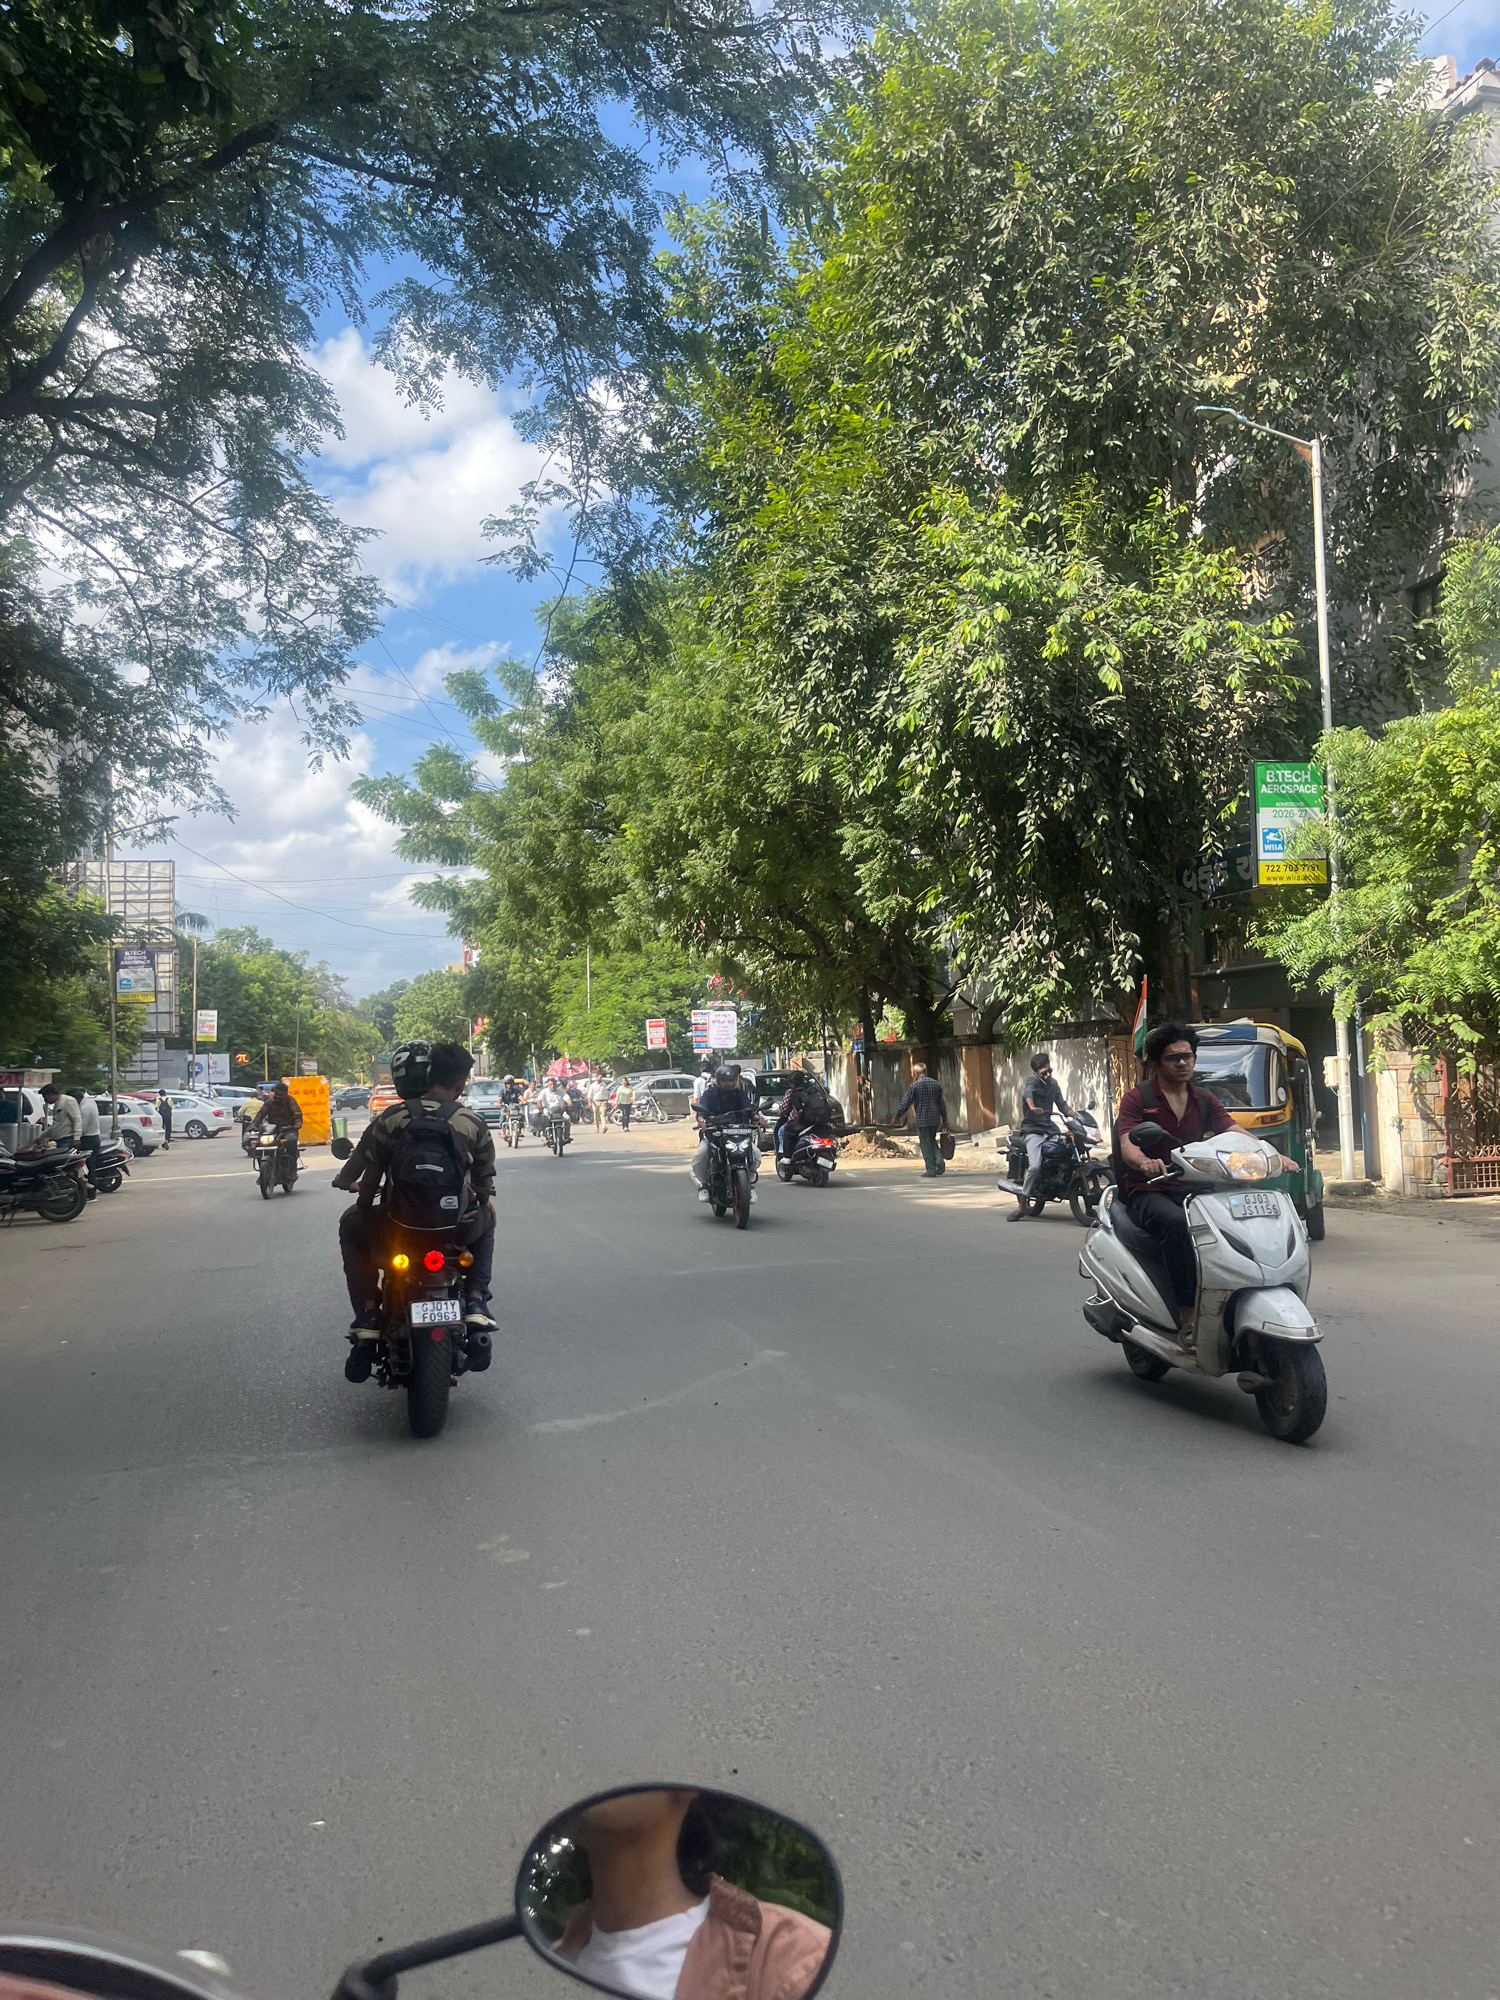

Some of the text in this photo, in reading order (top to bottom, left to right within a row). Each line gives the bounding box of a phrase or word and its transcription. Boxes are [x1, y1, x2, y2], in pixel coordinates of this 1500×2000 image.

[1266, 770, 1311, 783] B.TECH
[1260, 784, 1318, 794] AEROSPACE
[1272, 809, 1308, 819] 2026-27
[1264, 843, 1284, 851] WIIA
[1265, 864, 1281, 872] 722
[1244, 1193, 1269, 1205] GJ03
[1242, 1203, 1279, 1216] JS1156
[421, 1301, 456, 1312] GJ01Y
[422, 1311, 457, 1323] F0963
